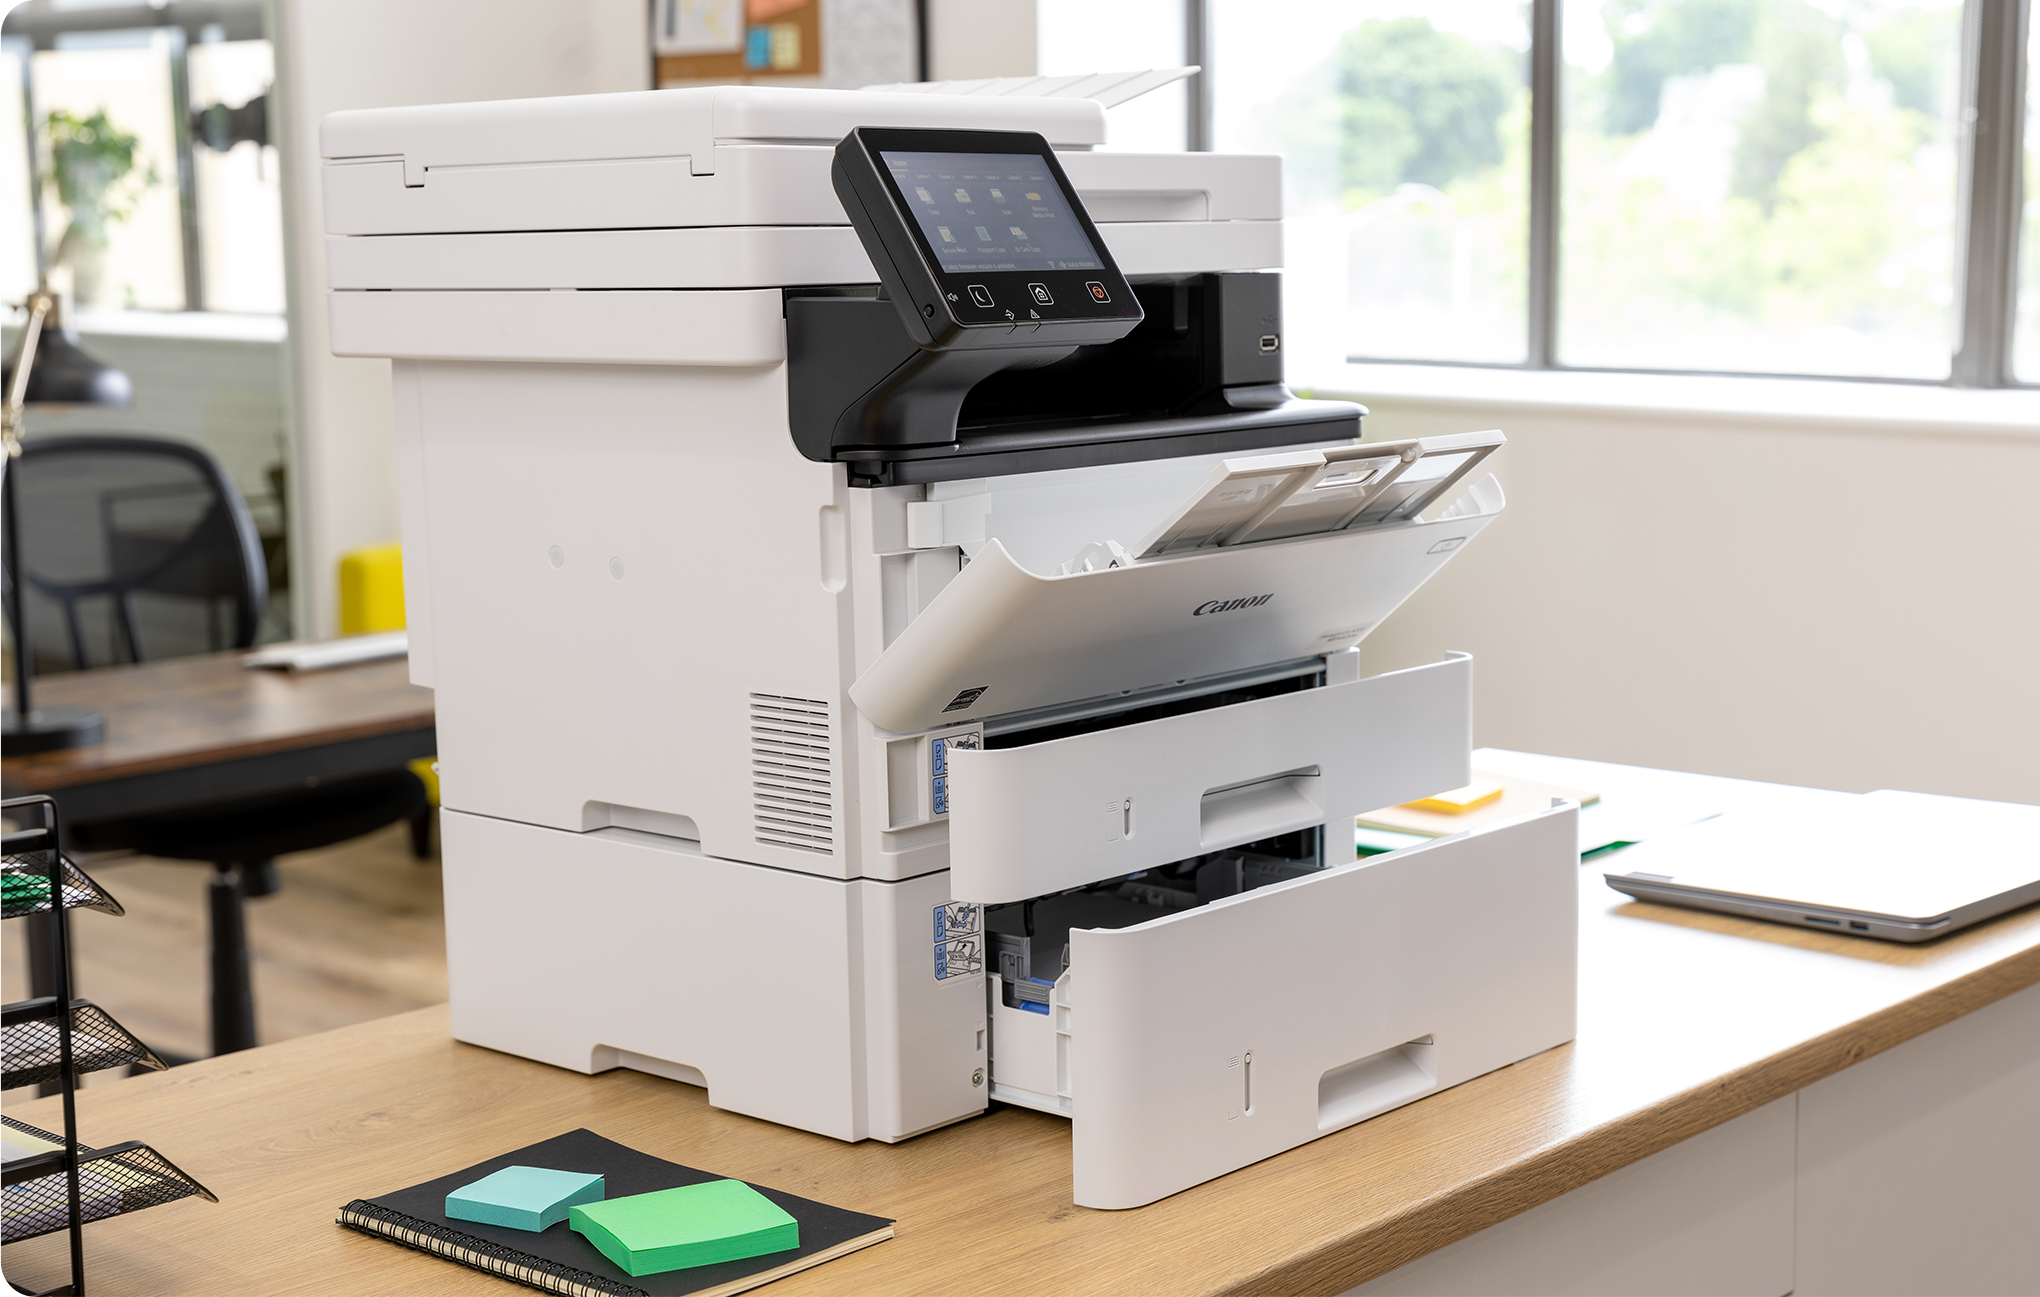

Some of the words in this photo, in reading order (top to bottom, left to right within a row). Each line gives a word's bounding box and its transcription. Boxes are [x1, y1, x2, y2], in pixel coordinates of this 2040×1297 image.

[928, 208, 940, 216] Copy
[1031, 205, 1049, 213] Memory
[1193, 593, 1274, 616] Canon
